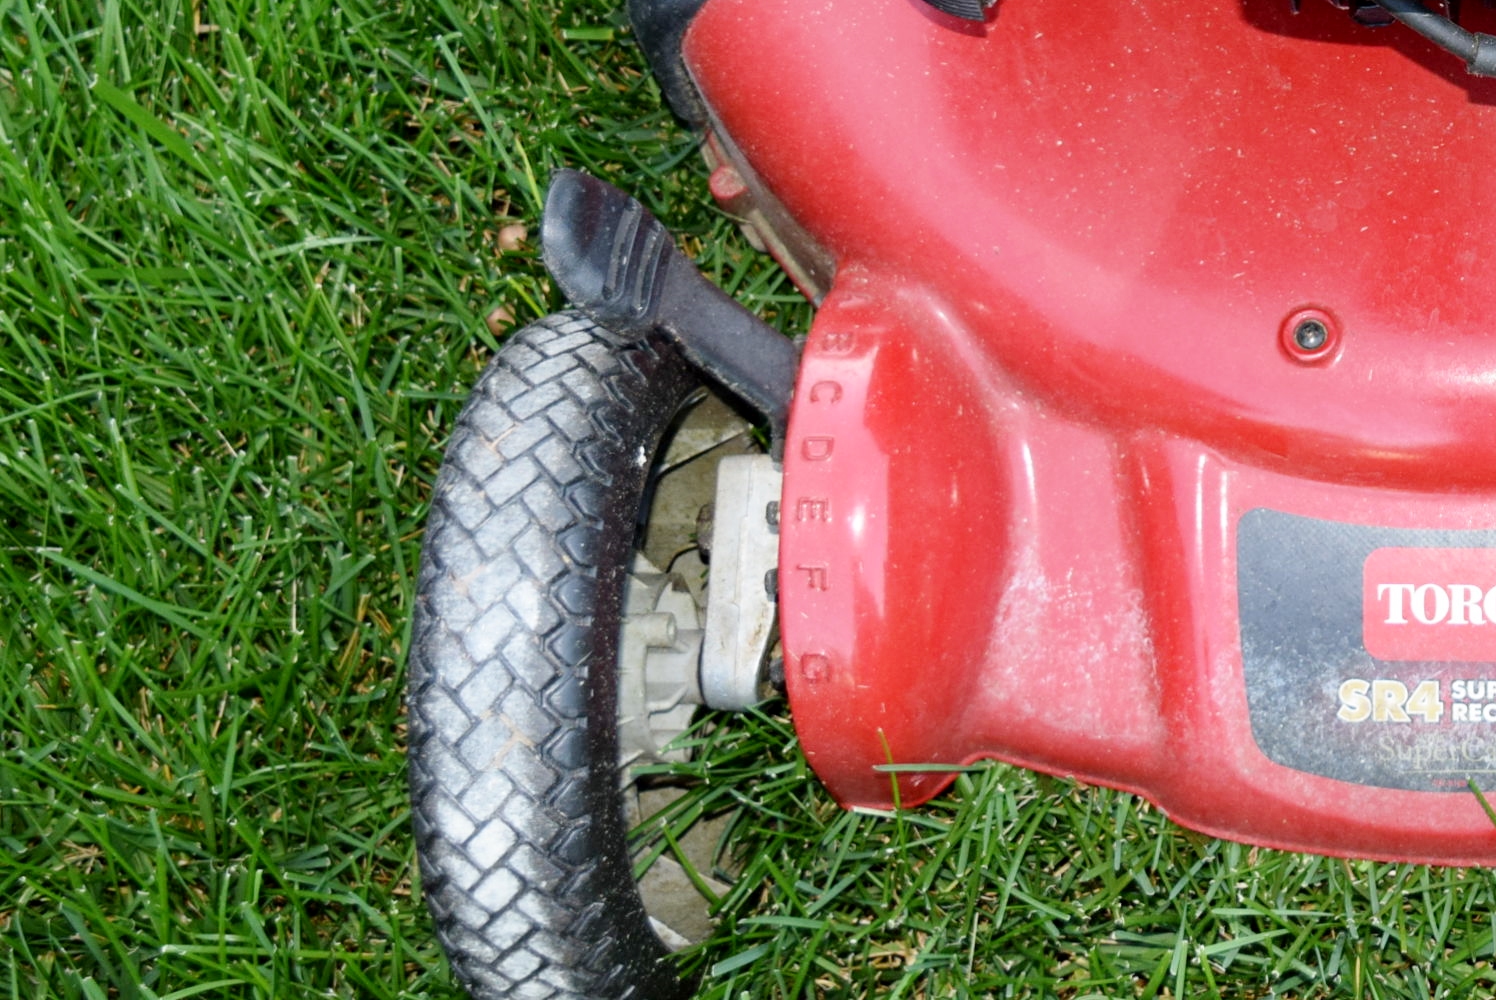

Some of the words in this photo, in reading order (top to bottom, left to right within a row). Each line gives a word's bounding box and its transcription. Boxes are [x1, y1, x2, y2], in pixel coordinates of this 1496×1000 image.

[809, 379, 844, 406] C
[801, 436, 835, 462] D
[796, 496, 833, 525] E
[796, 563, 831, 593] F
[1337, 677, 1445, 724] SR4
